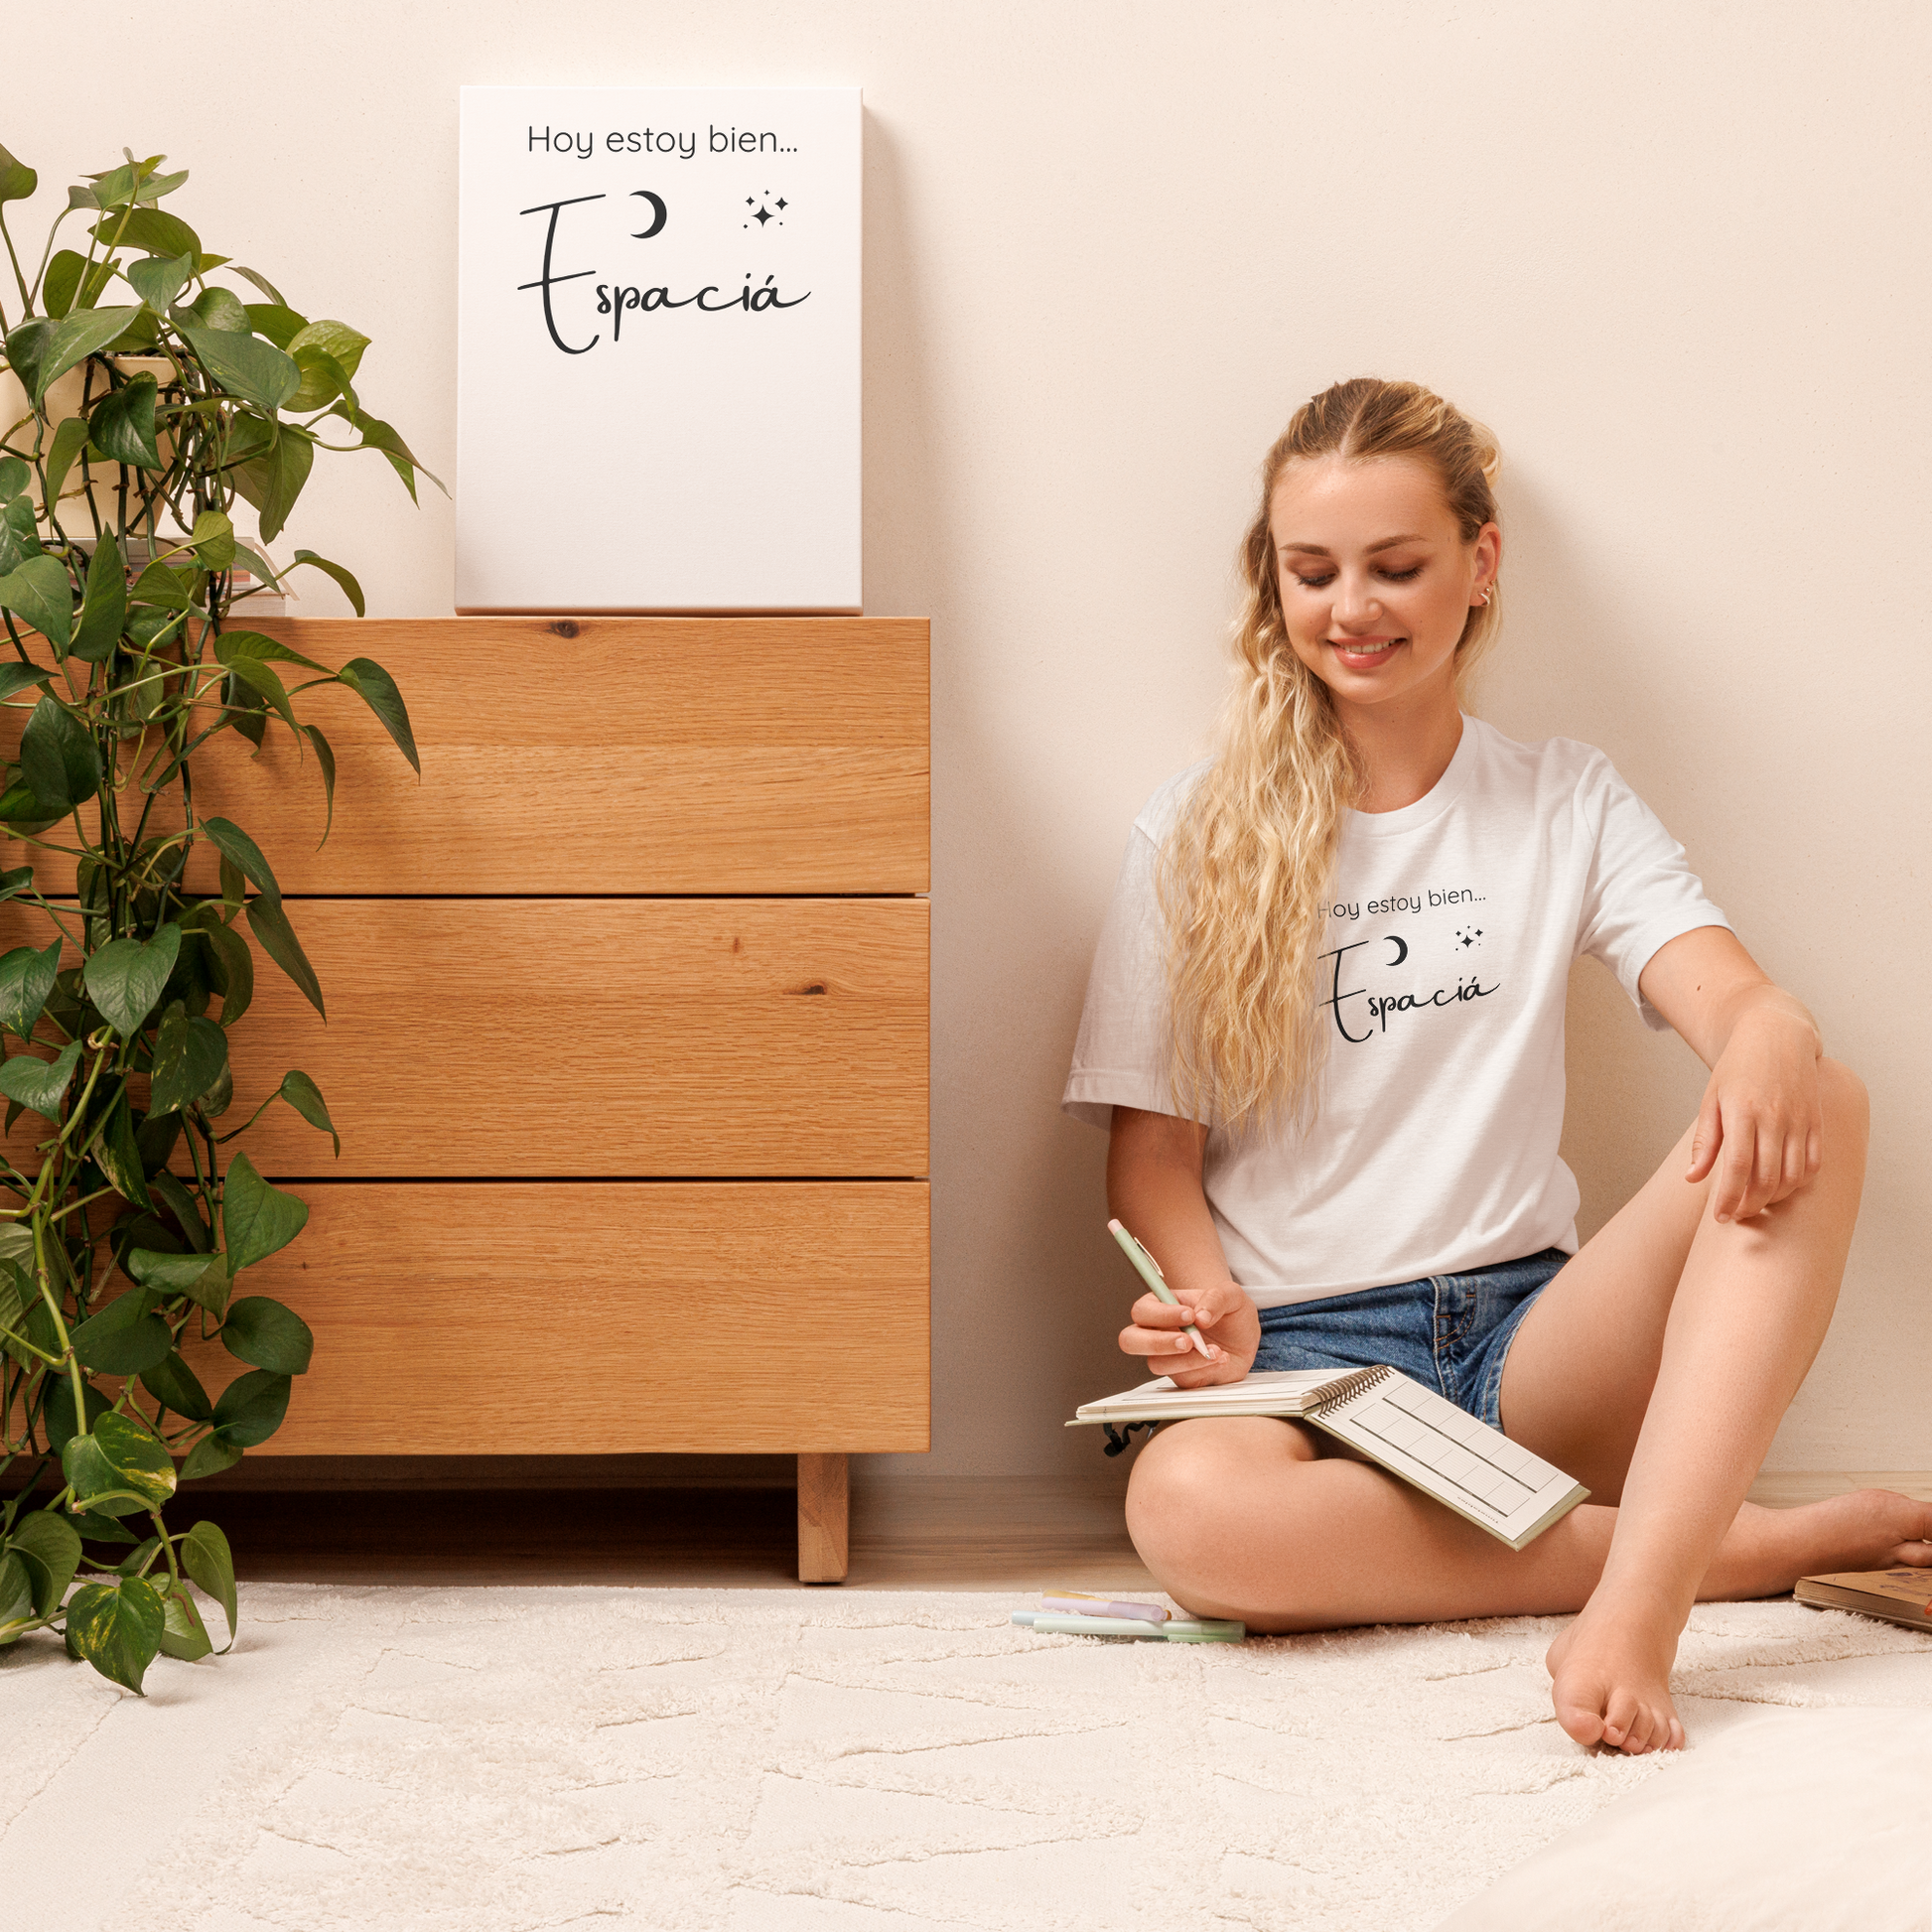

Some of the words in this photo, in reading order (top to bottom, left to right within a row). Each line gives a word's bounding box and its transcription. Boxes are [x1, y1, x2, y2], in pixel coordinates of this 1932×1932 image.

[528, 125, 594, 160] Hoy
[606, 127, 696, 160] estoy
[709, 124, 798, 153] bien...
[517, 193, 812, 355] Espaciá
[1316, 900, 1360, 920] Hoy
[1367, 896, 1422, 914] estoy
[1428, 889, 1487, 907] bien...
[1316, 940, 1501, 1043] Espaciá
